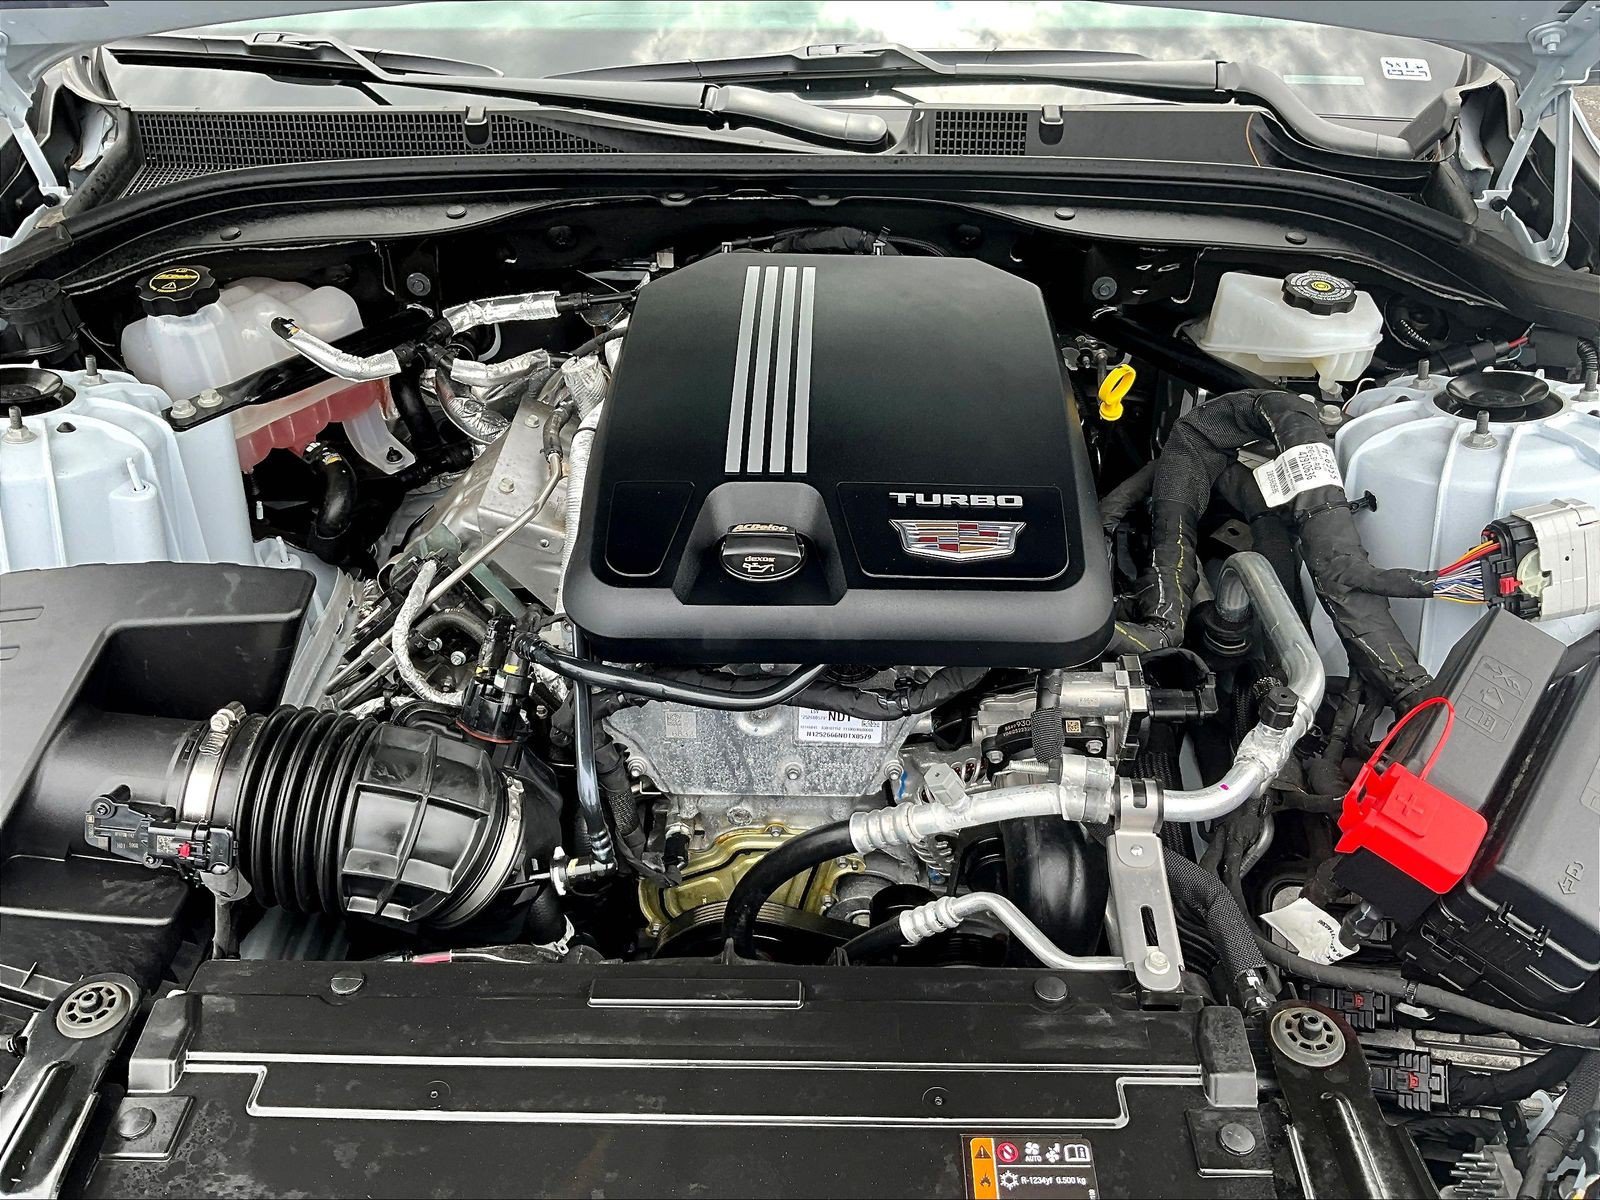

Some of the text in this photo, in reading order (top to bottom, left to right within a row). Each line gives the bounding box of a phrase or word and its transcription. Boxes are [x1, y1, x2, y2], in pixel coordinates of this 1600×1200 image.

[889, 491, 1024, 508] TURBO
[731, 523, 789, 533] ACDelco
[1025, 1155, 1042, 1163] AUTO
[1020, 1176, 1087, 1186] R-1234yf 0.500 kg
